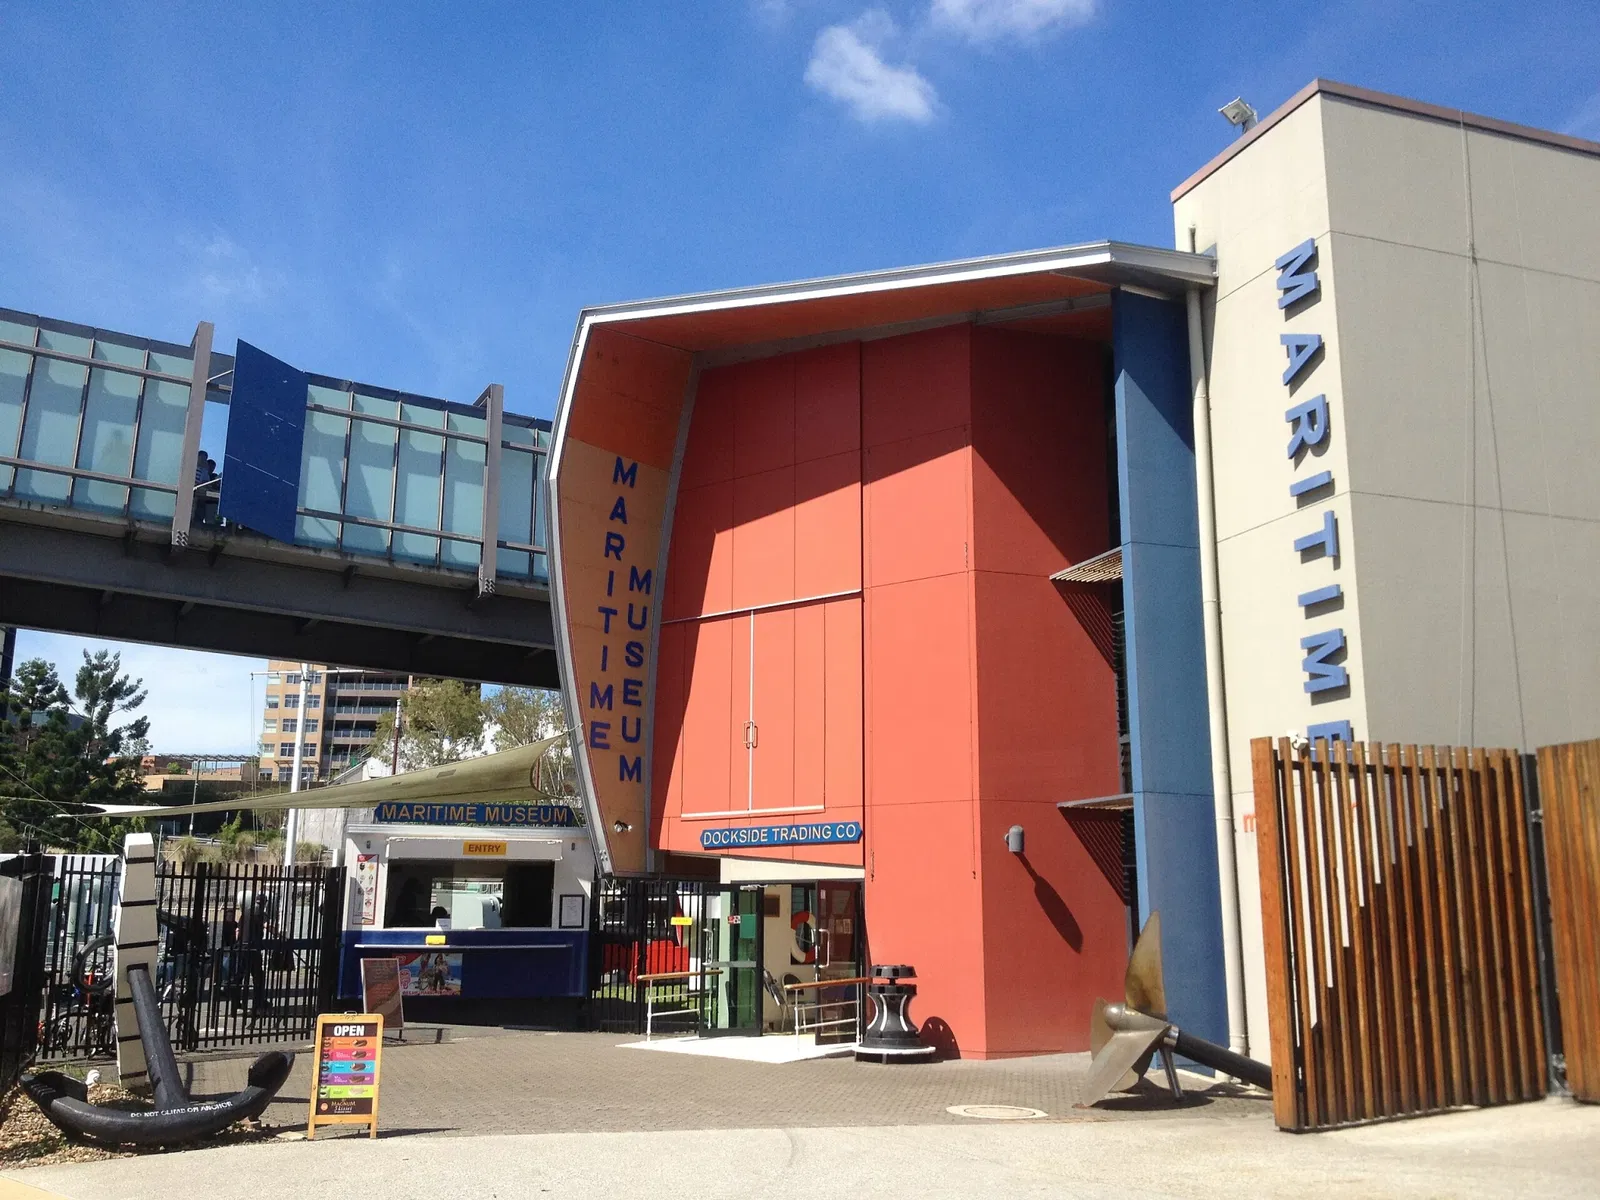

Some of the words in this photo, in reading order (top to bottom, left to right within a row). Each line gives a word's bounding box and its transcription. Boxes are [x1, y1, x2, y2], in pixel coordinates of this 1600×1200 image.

[1275, 237, 1354, 763] MARITIME
[589, 456, 638, 750] MARITIME
[619, 565, 652, 783] MUSEUM
[381, 804, 478, 821] MARITIME
[485, 806, 567, 823] MUSEUM
[703, 828, 768, 845] DOCKSIDE
[772, 825, 832, 842] TRADING
[835, 824, 856, 838] CO
[468, 844, 501, 853] ENTRY
[333, 1025, 365, 1036] OPEN
[200, 1101, 233, 1112] ANCHOR
